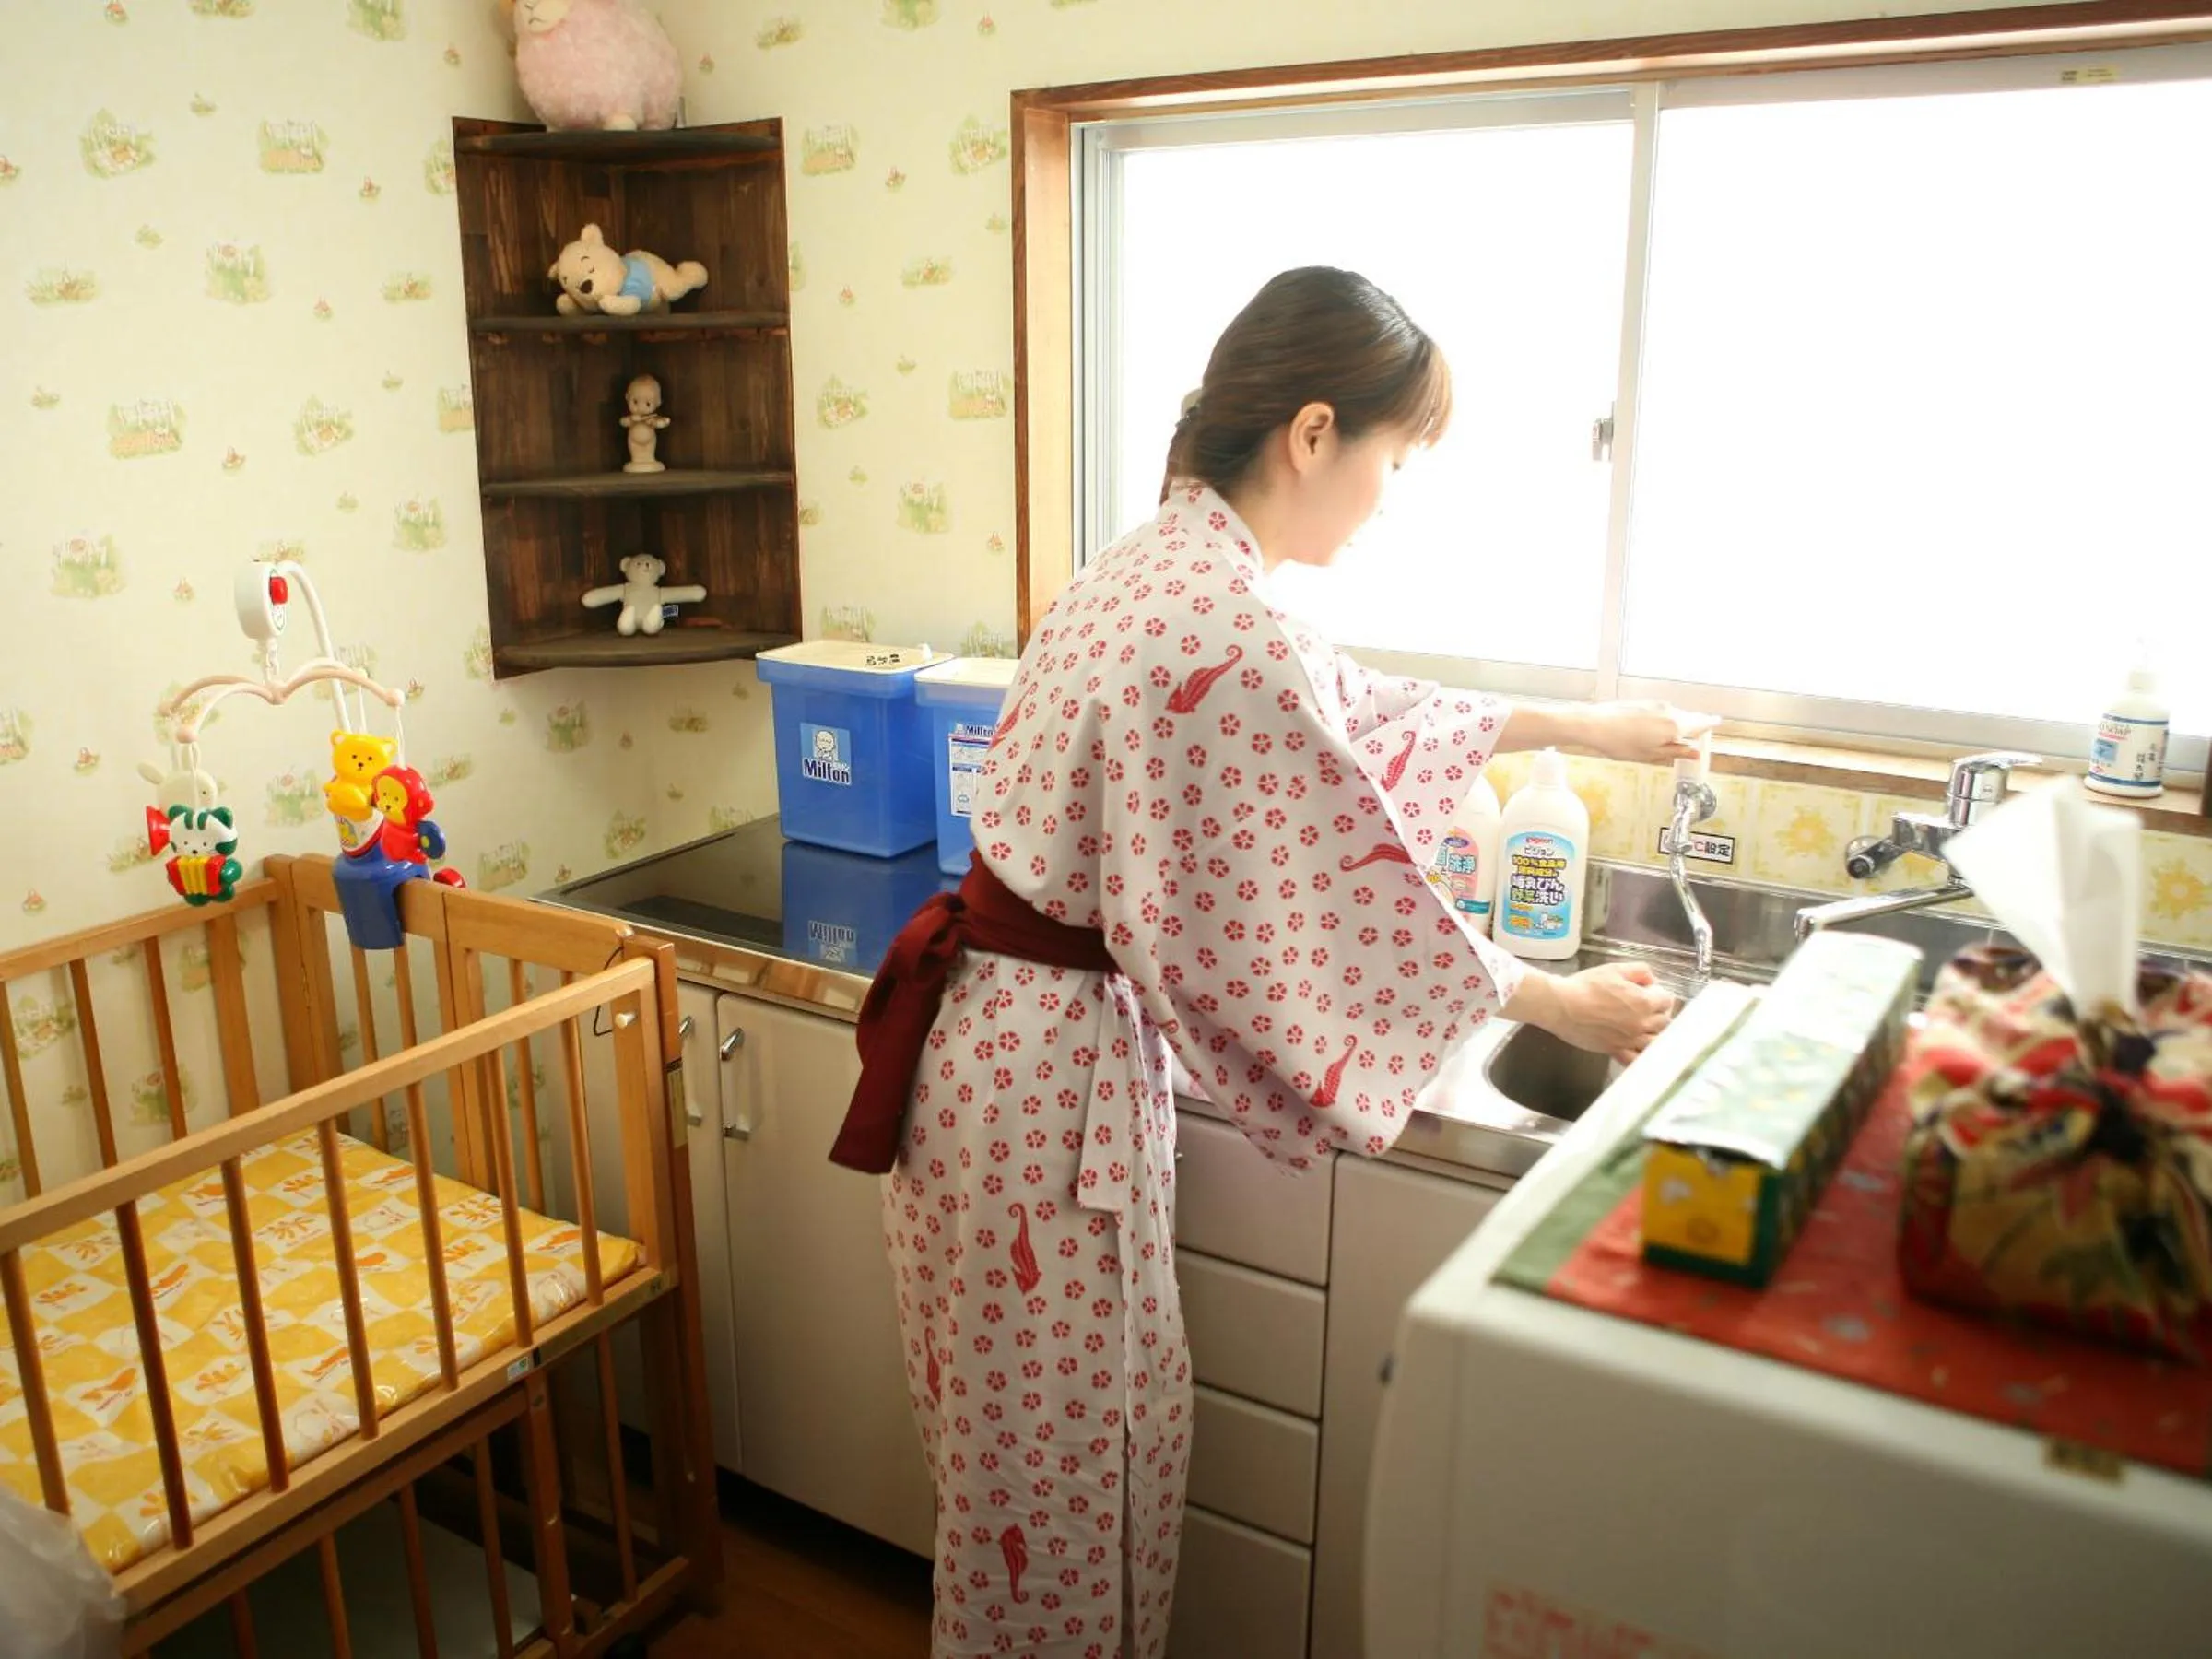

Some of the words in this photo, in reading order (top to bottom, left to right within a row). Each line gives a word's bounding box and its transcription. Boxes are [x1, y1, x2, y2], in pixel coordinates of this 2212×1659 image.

[804, 759, 850, 783] Milton
[1524, 846, 1555, 856] ピジョン
[1511, 876, 1565, 891] 哺乳びん
[1510, 888, 1565, 906] 野菜洗い
